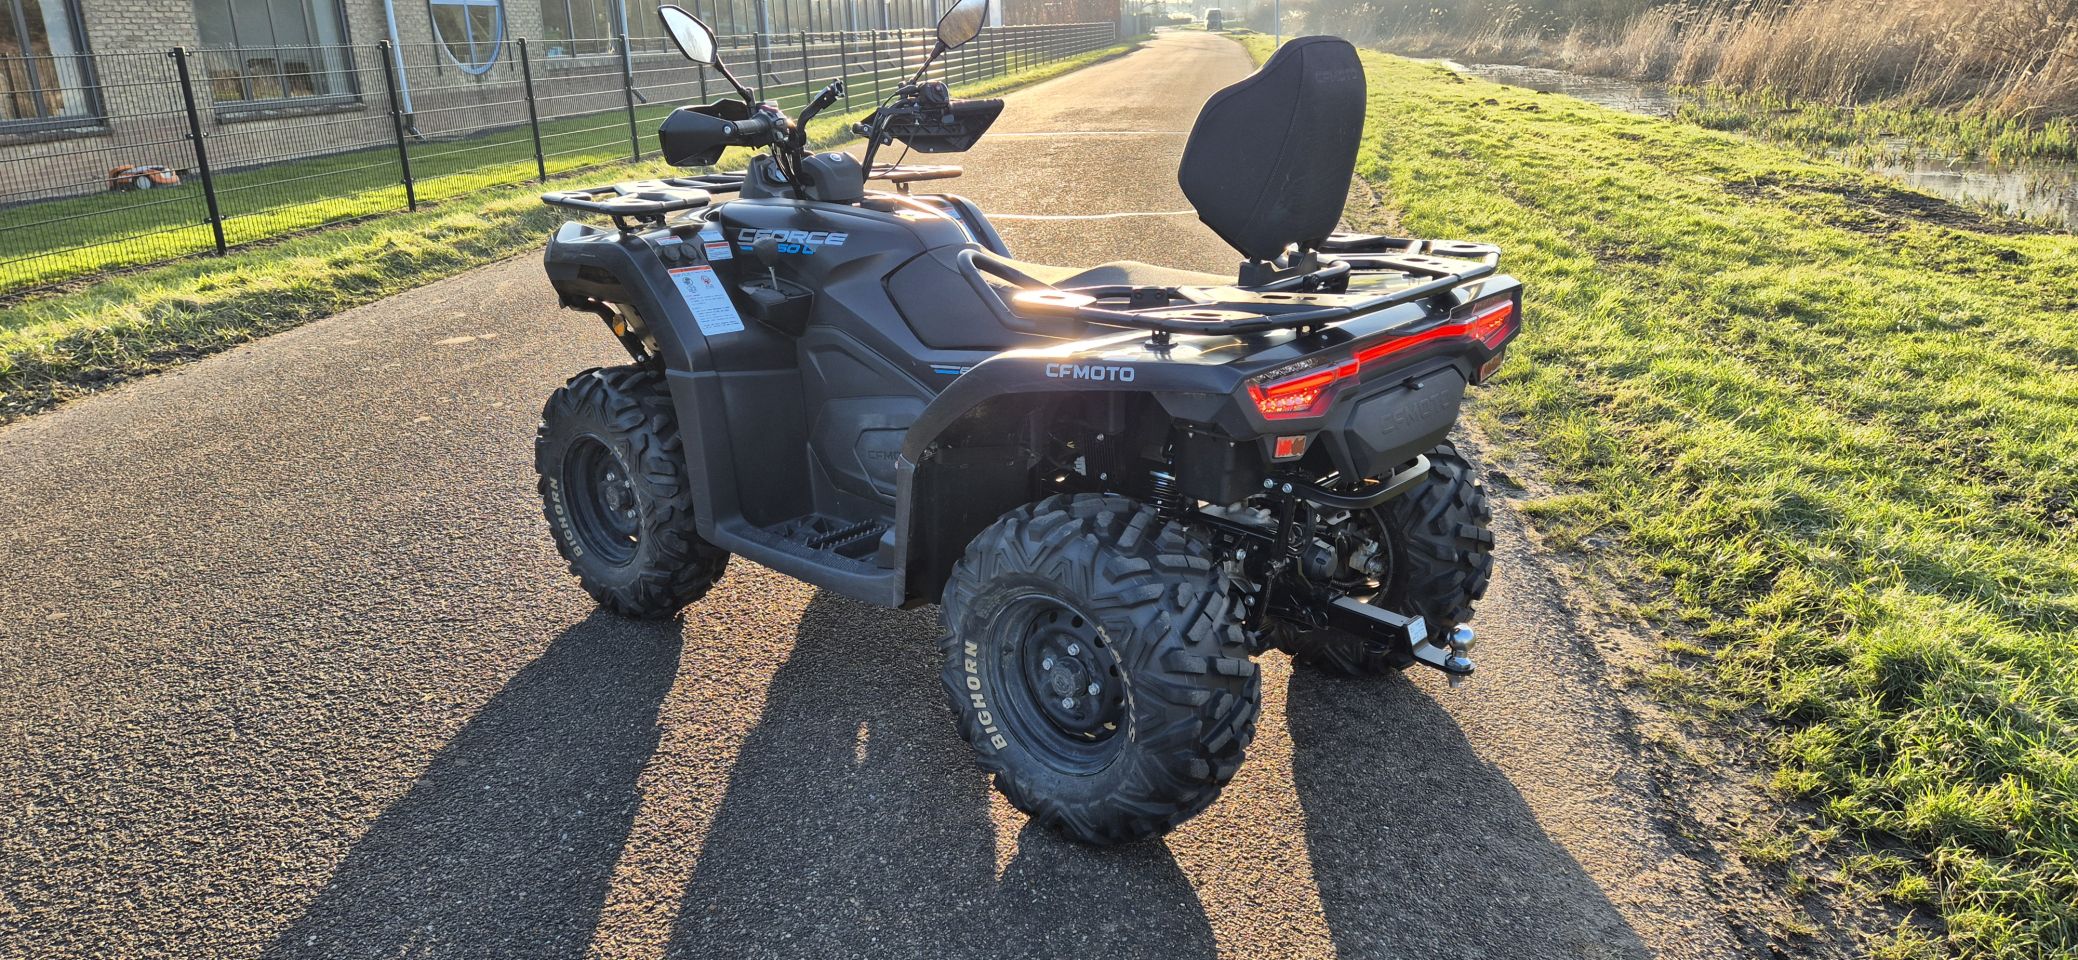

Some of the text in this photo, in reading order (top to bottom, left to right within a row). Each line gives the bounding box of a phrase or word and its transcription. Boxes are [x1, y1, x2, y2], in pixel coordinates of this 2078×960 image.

[738, 228, 848, 246] CFORCE
[1046, 363, 1135, 382] CFMOTO
[549, 477, 583, 557] BIGHORN
[964, 641, 1008, 750] BIGHORN
